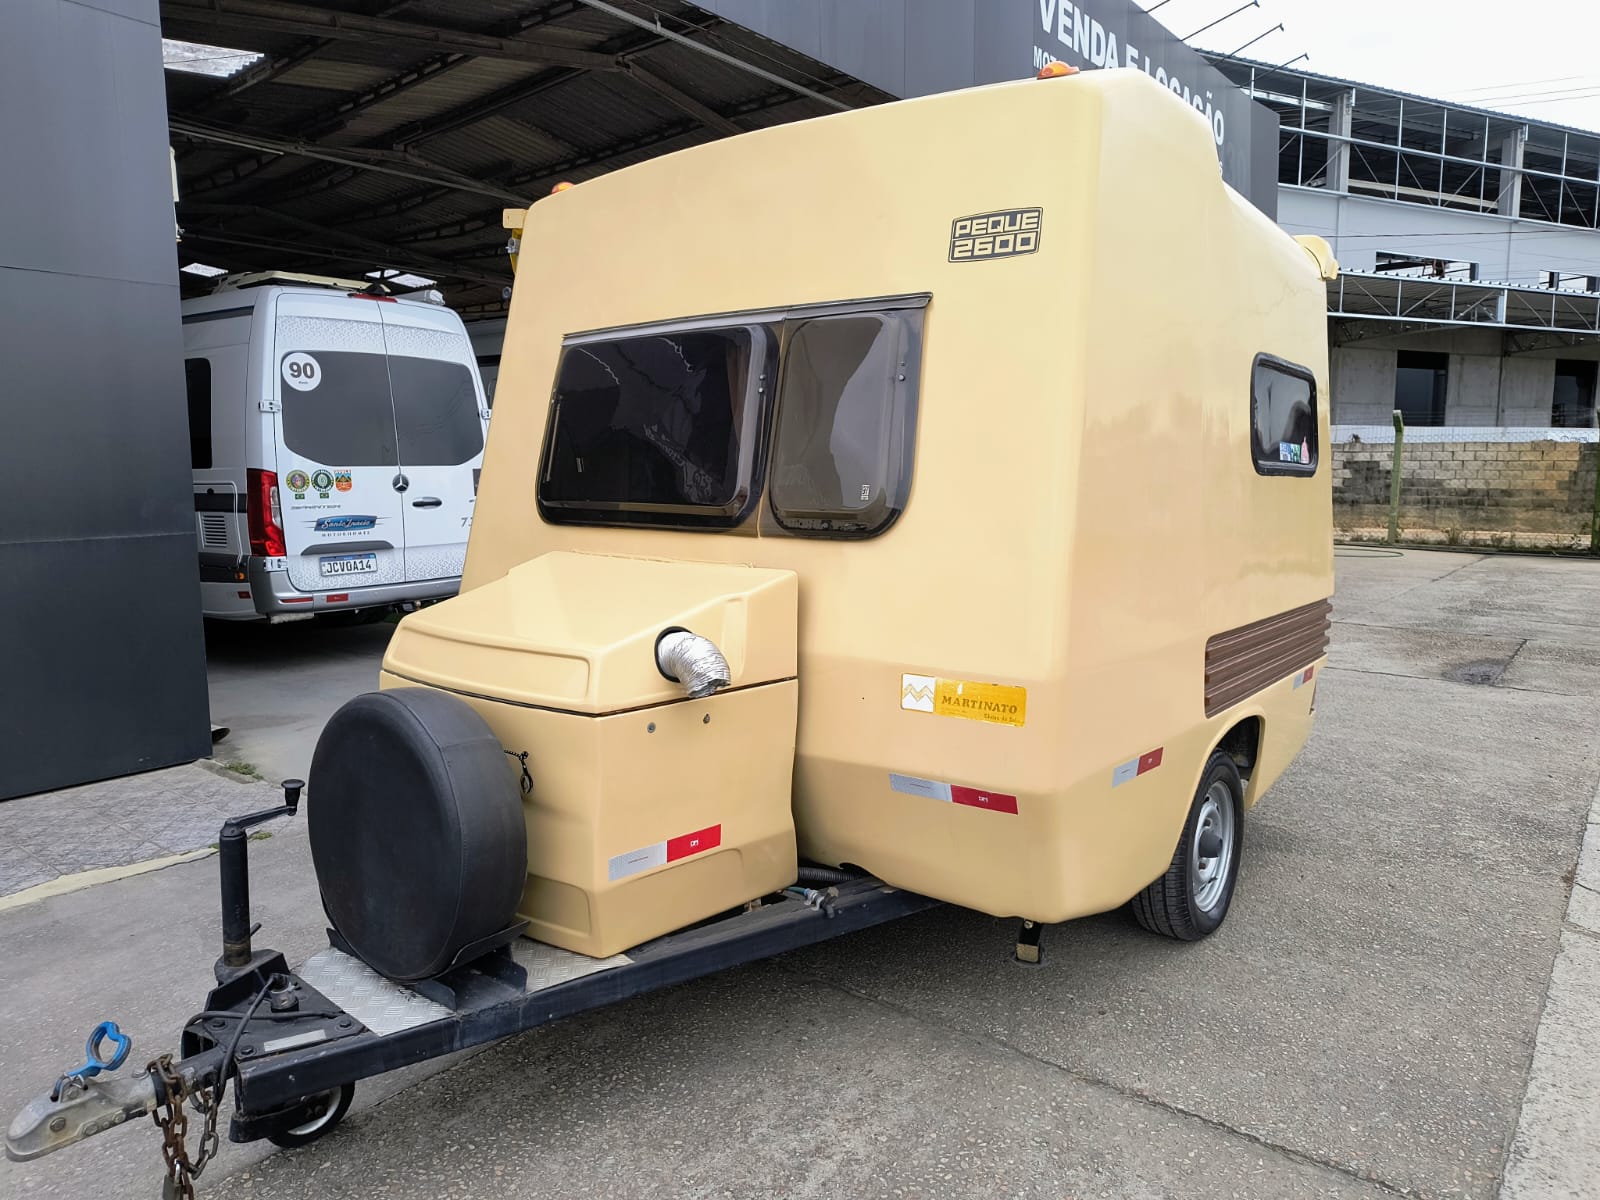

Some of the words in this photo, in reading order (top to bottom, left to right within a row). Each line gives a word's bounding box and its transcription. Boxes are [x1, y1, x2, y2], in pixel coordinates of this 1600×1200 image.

[1039, 0, 1119, 69] VENDA
[954, 211, 1040, 238] PEQUE
[953, 231, 1037, 258] 2600
[288, 361, 315, 379] 90
[941, 695, 1018, 714] MARTINATO
